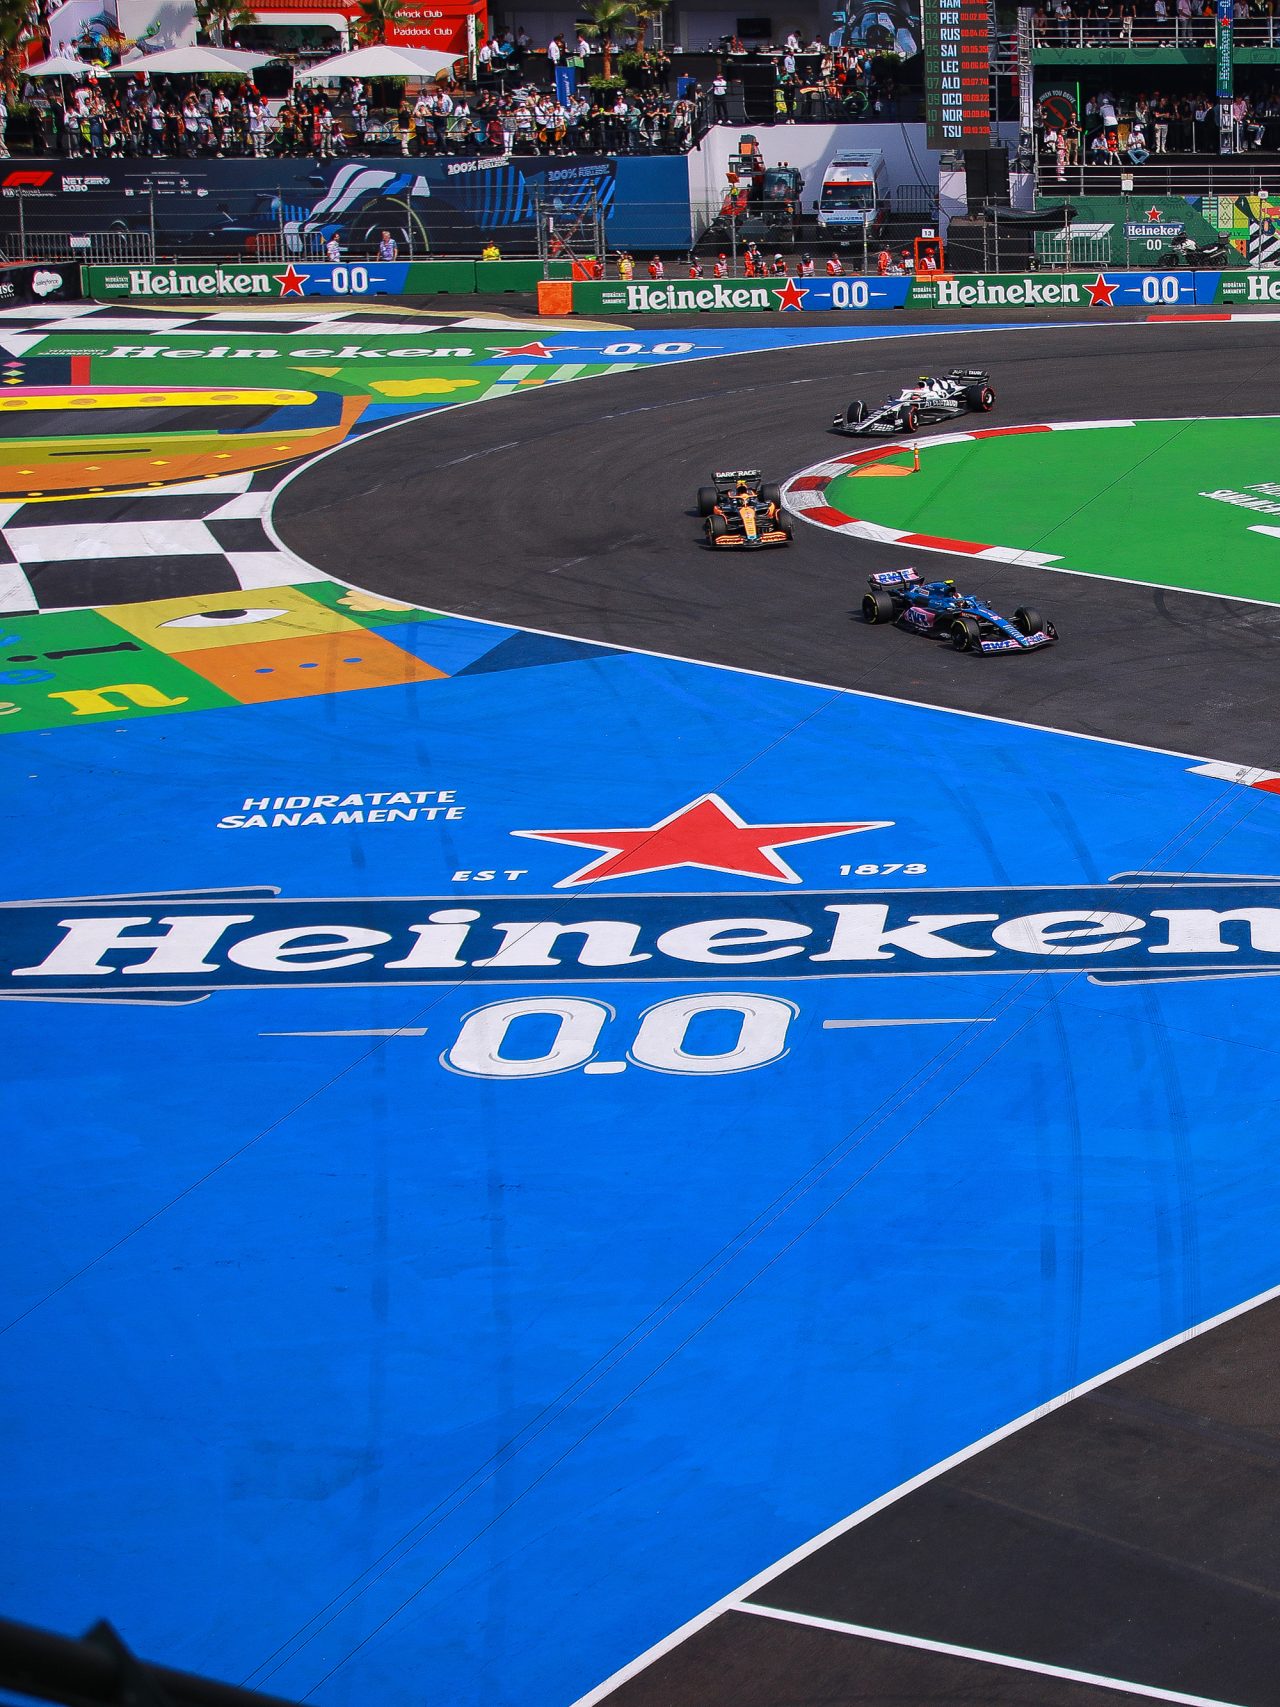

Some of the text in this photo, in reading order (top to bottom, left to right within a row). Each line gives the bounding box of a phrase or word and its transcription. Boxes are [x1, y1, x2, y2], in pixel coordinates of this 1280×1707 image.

[940, 12, 959, 24] PER
[394, 28, 453, 36] Paddock Club
[941, 28, 960, 40] RUS
[941, 44, 957, 57] SAI
[941, 60, 959, 73] LEC
[942, 77, 960, 89] ALO
[942, 93, 962, 105] OCO
[943, 109, 963, 121] NOR
[942, 125, 962, 138] TSU
[448, 161, 477, 175] 100%
[548, 168, 577, 181] 100%
[62, 177, 83, 185] NET
[62, 184, 88, 192] 2030
[129, 267, 368, 294] Heineken 0.0
[627, 281, 868, 310] Heineken 0.0
[937, 276, 1179, 305] Heineken 0.0
[100, 346, 476, 359] Heineken
[242, 791, 457, 811] HIDRATATE
[216, 806, 466, 829] SANAMENTE
[451, 863, 928, 883] EST 1873
[441, 997, 797, 1079] 0.0
